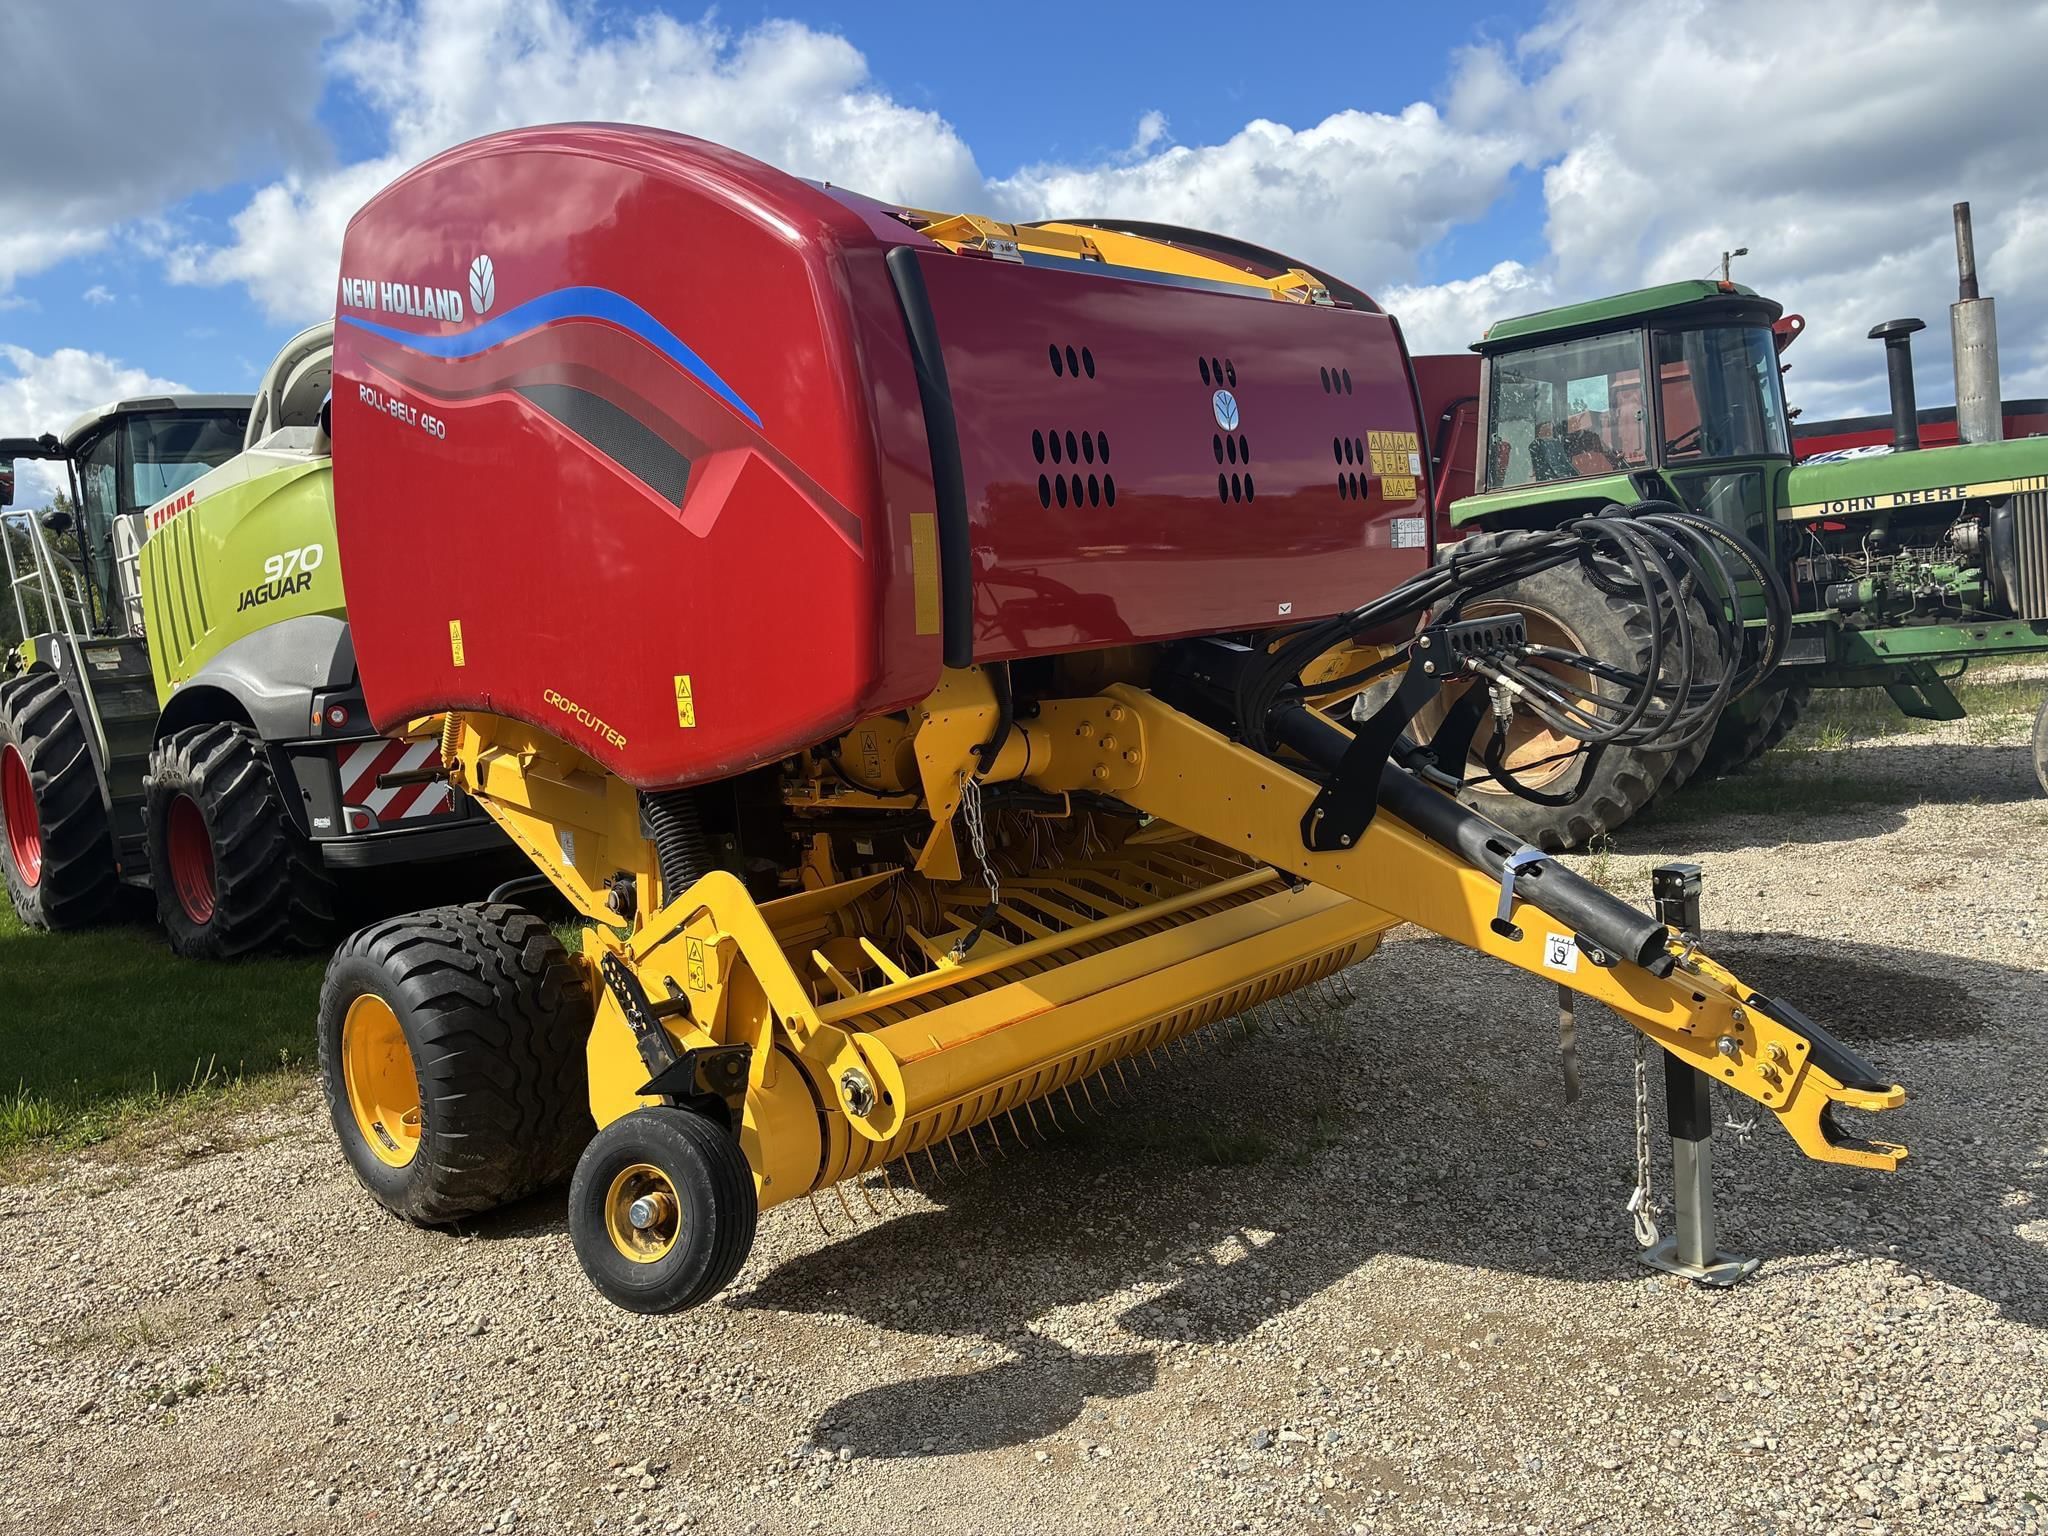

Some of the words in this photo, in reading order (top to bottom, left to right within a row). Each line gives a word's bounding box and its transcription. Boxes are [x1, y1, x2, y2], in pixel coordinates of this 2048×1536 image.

[342, 277, 376, 310] NEW
[380, 281, 464, 323] HOLLAND
[359, 383, 417, 427] ROLL-BELT
[420, 413, 446, 440] 450
[1820, 497, 1875, 515] JOHN
[1893, 486, 1967, 506] DEERE
[264, 543, 324, 584] 970
[236, 571, 312, 613] JAGUAR
[543, 688, 627, 751] CROPCUTTER
